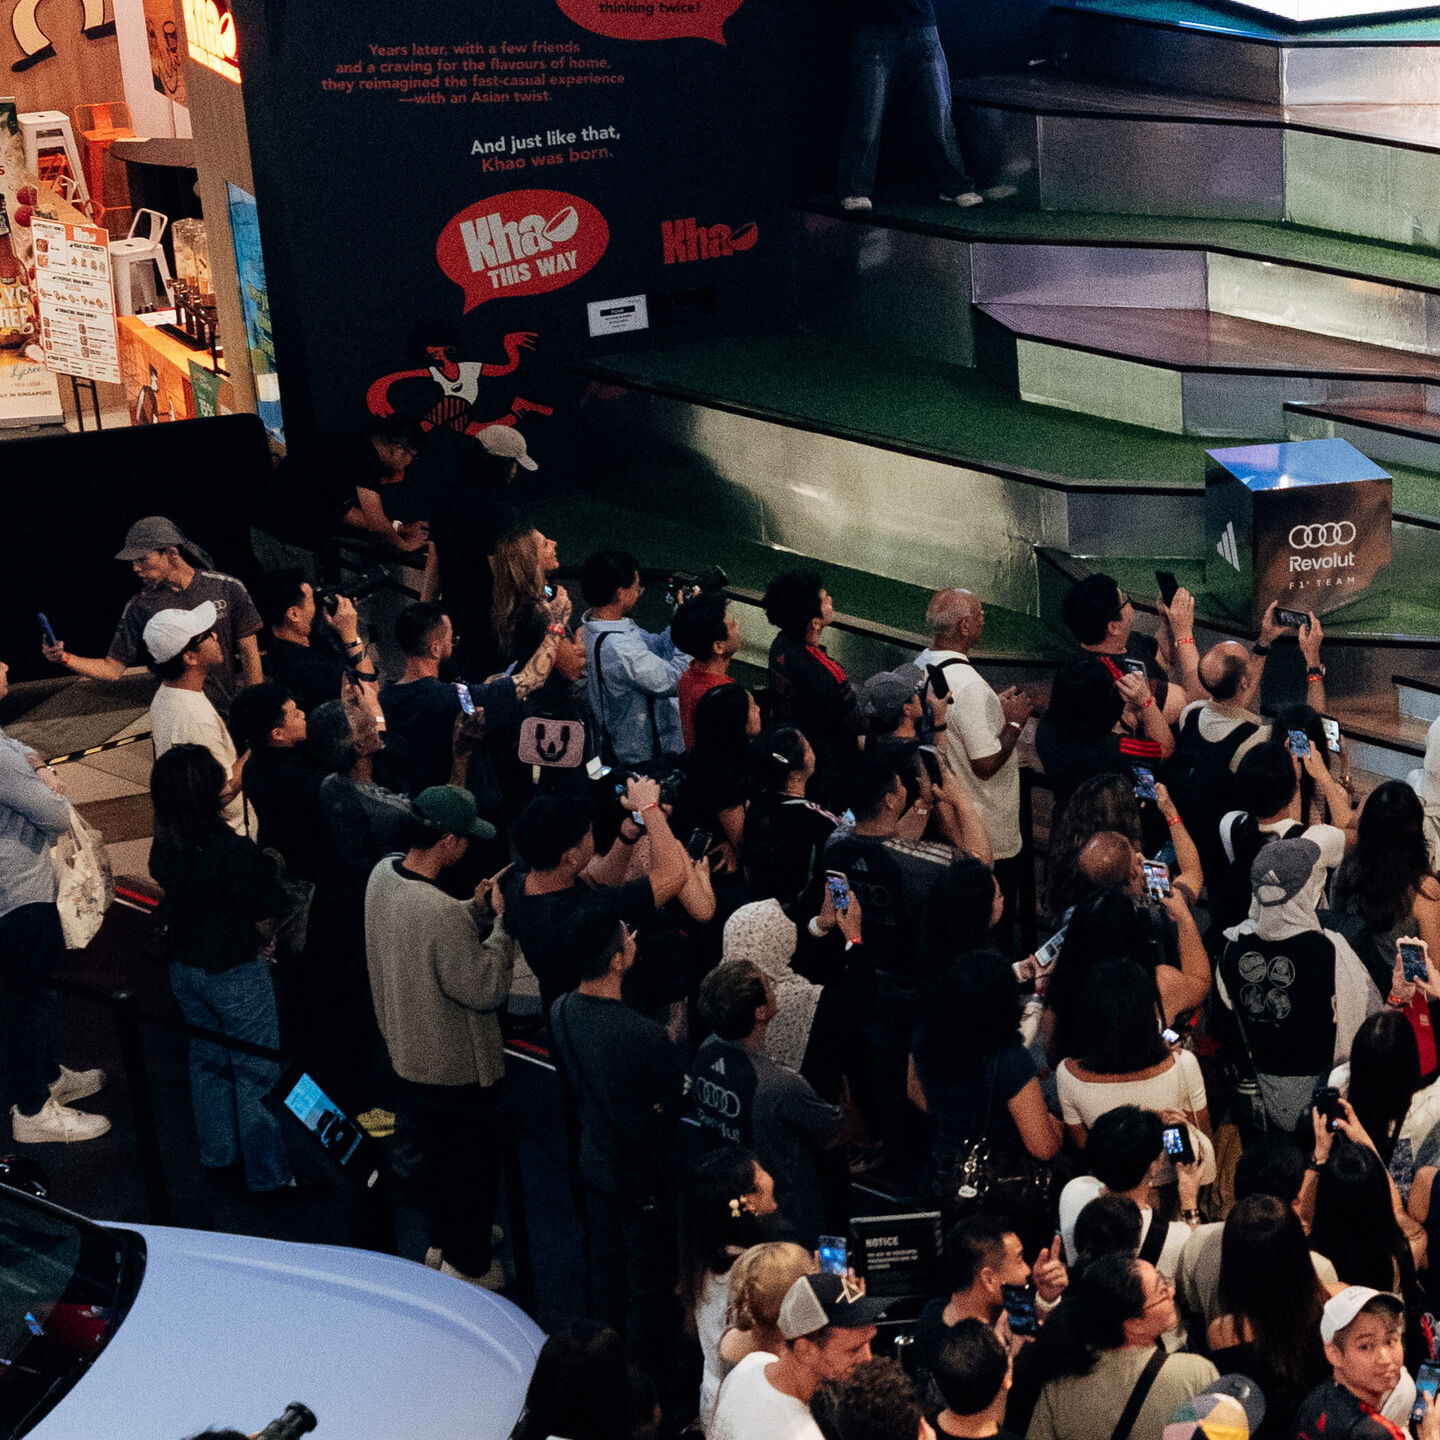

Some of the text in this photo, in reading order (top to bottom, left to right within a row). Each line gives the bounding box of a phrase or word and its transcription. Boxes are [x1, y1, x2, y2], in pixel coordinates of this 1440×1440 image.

[599, 1, 701, 17] thinking twice!
[368, 43, 408, 57] Years
[411, 42, 448, 57] later,
[452, 42, 485, 55] with
[488, 45, 497, 55] a
[501, 41, 528, 55] few
[336, 60, 363, 74] and
[366, 63, 376, 74] a
[379, 60, 433, 76] craving
[436, 58, 458, 72] for
[461, 58, 486, 71] the
[490, 57, 546, 71] flavours
[549, 56, 565, 69] of
[321, 72, 625, 94] they reimagined the fast-casual experience
[450, 94, 468, 104] an
[471, 91, 510, 103] Asian
[513, 90, 553, 103] twist.
[470, 125, 621, 155] And just like that,
[481, 147, 614, 173] Khao was born.
[487, 249, 579, 290] THIS WAY
[1289, 551, 1355, 572] Revolut
[1316, 576, 1355, 587] TEAM
